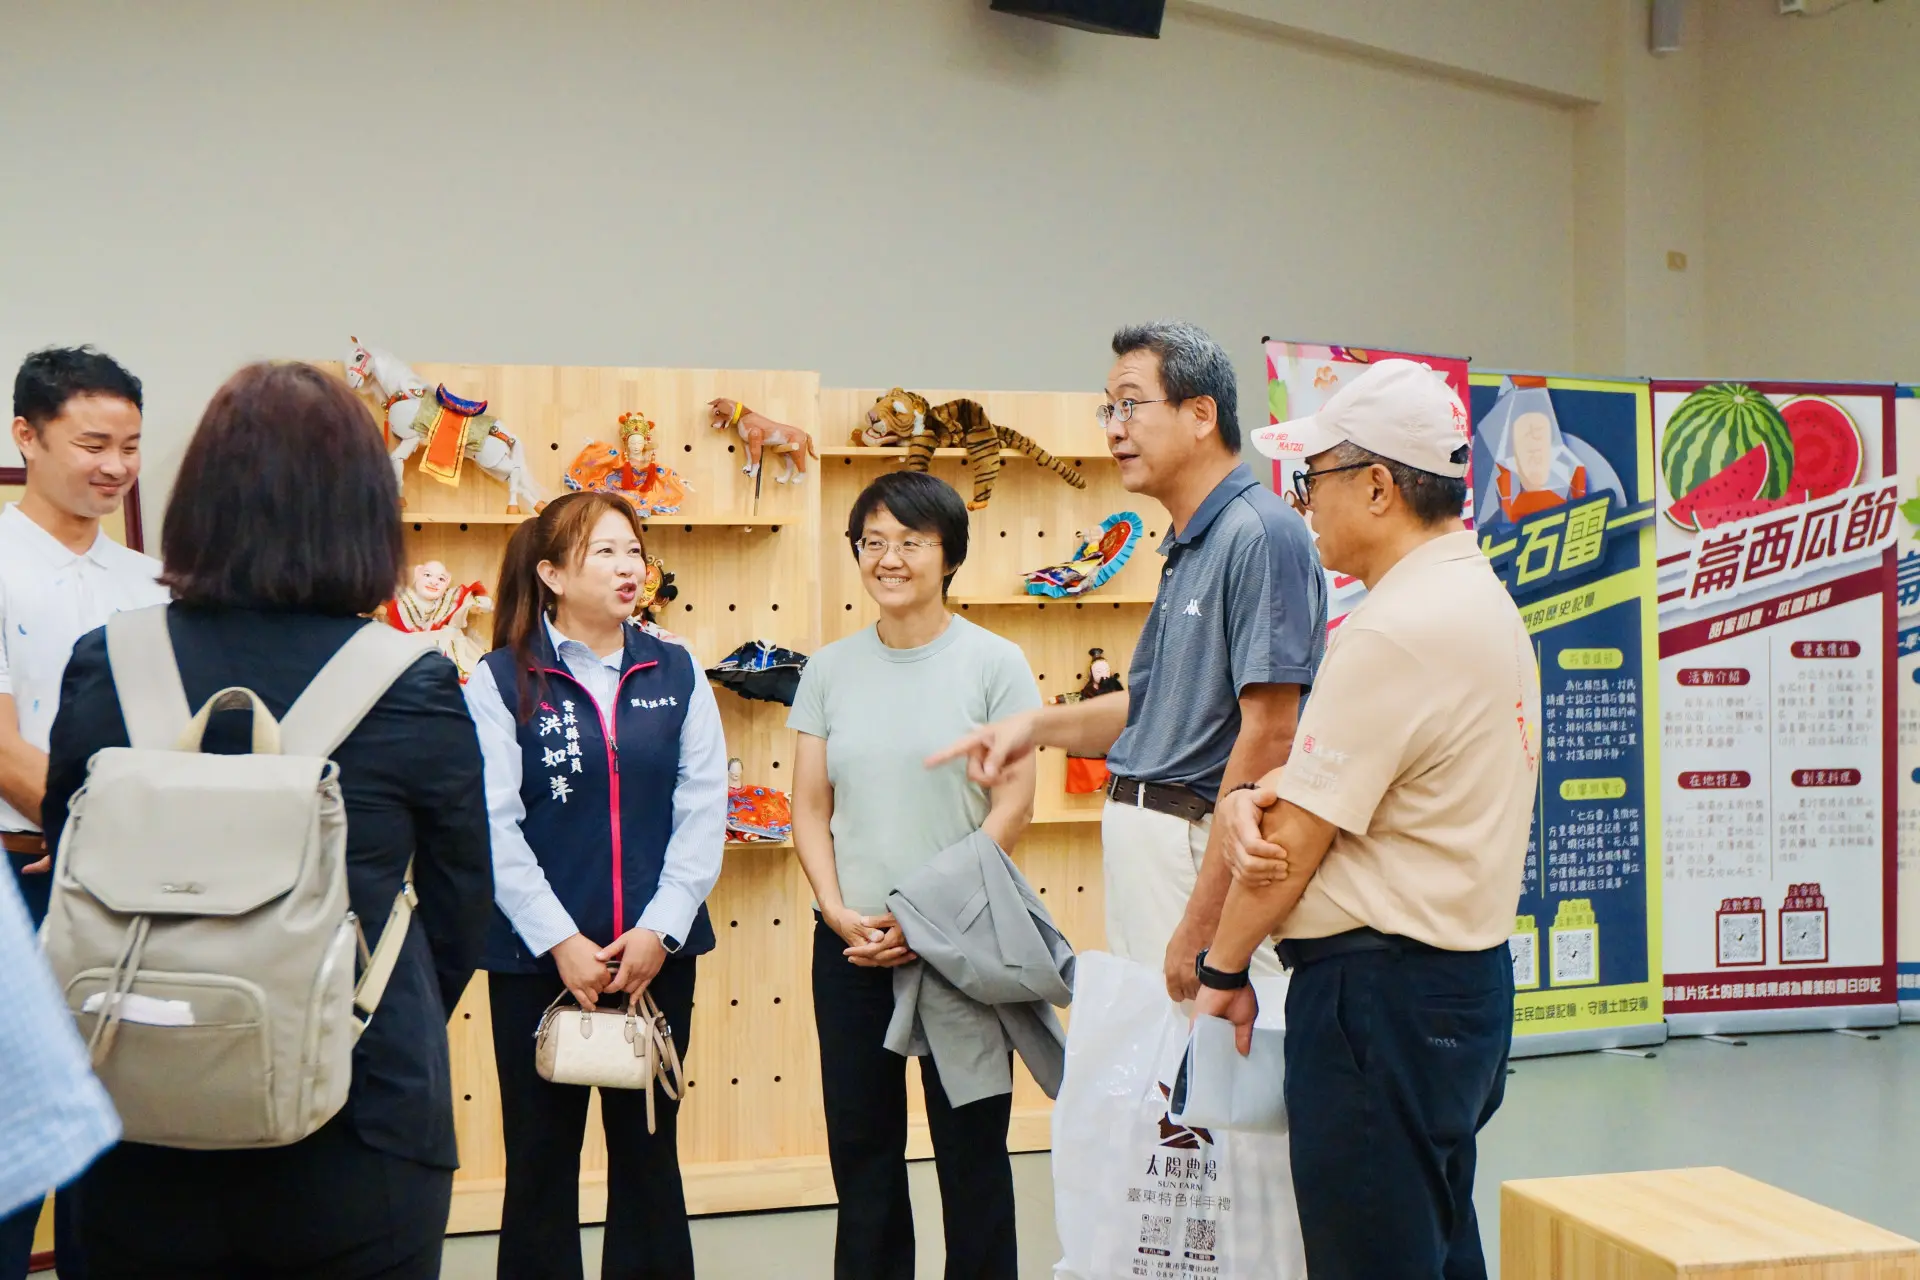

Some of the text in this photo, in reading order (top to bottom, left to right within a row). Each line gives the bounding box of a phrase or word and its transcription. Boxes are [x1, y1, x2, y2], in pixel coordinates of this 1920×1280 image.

[1278, 442, 1304, 452] MATZO
[1802, 643, 1850, 657] 營養價值
[1688, 670, 1740, 684] 活動介紹
[562, 700, 583, 774] 雲林縣議員
[539, 714, 573, 804] 洪如萍
[1689, 773, 1741, 787] 在地特色
[1802, 771, 1851, 785] 創意料理
[1722, 898, 1761, 911] 互動學習
[1784, 897, 1824, 909] 互動學習
[1146, 1154, 1218, 1181] 太陽農場
[1157, 1180, 1204, 1192] SUN FARM
[1127, 1187, 1232, 1212] 臺東特色伴手禮
